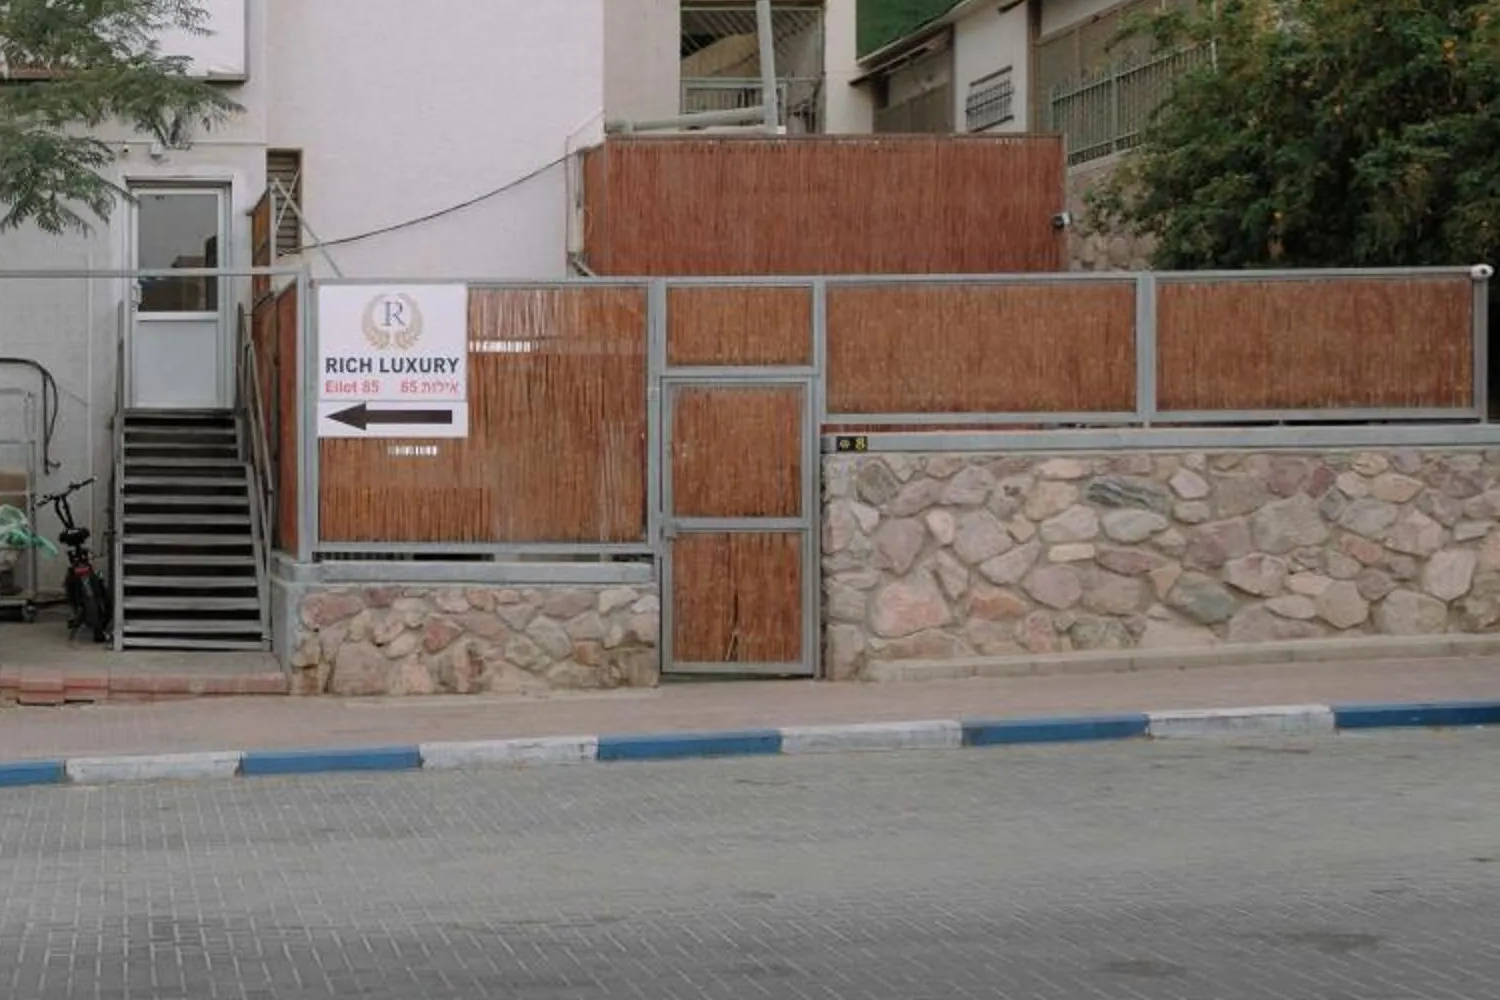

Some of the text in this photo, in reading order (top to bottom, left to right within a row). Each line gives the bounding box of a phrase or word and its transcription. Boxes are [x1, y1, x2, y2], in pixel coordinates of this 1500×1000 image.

[383, 301, 405, 327] R
[325, 357, 460, 374] RICH LUXURY
